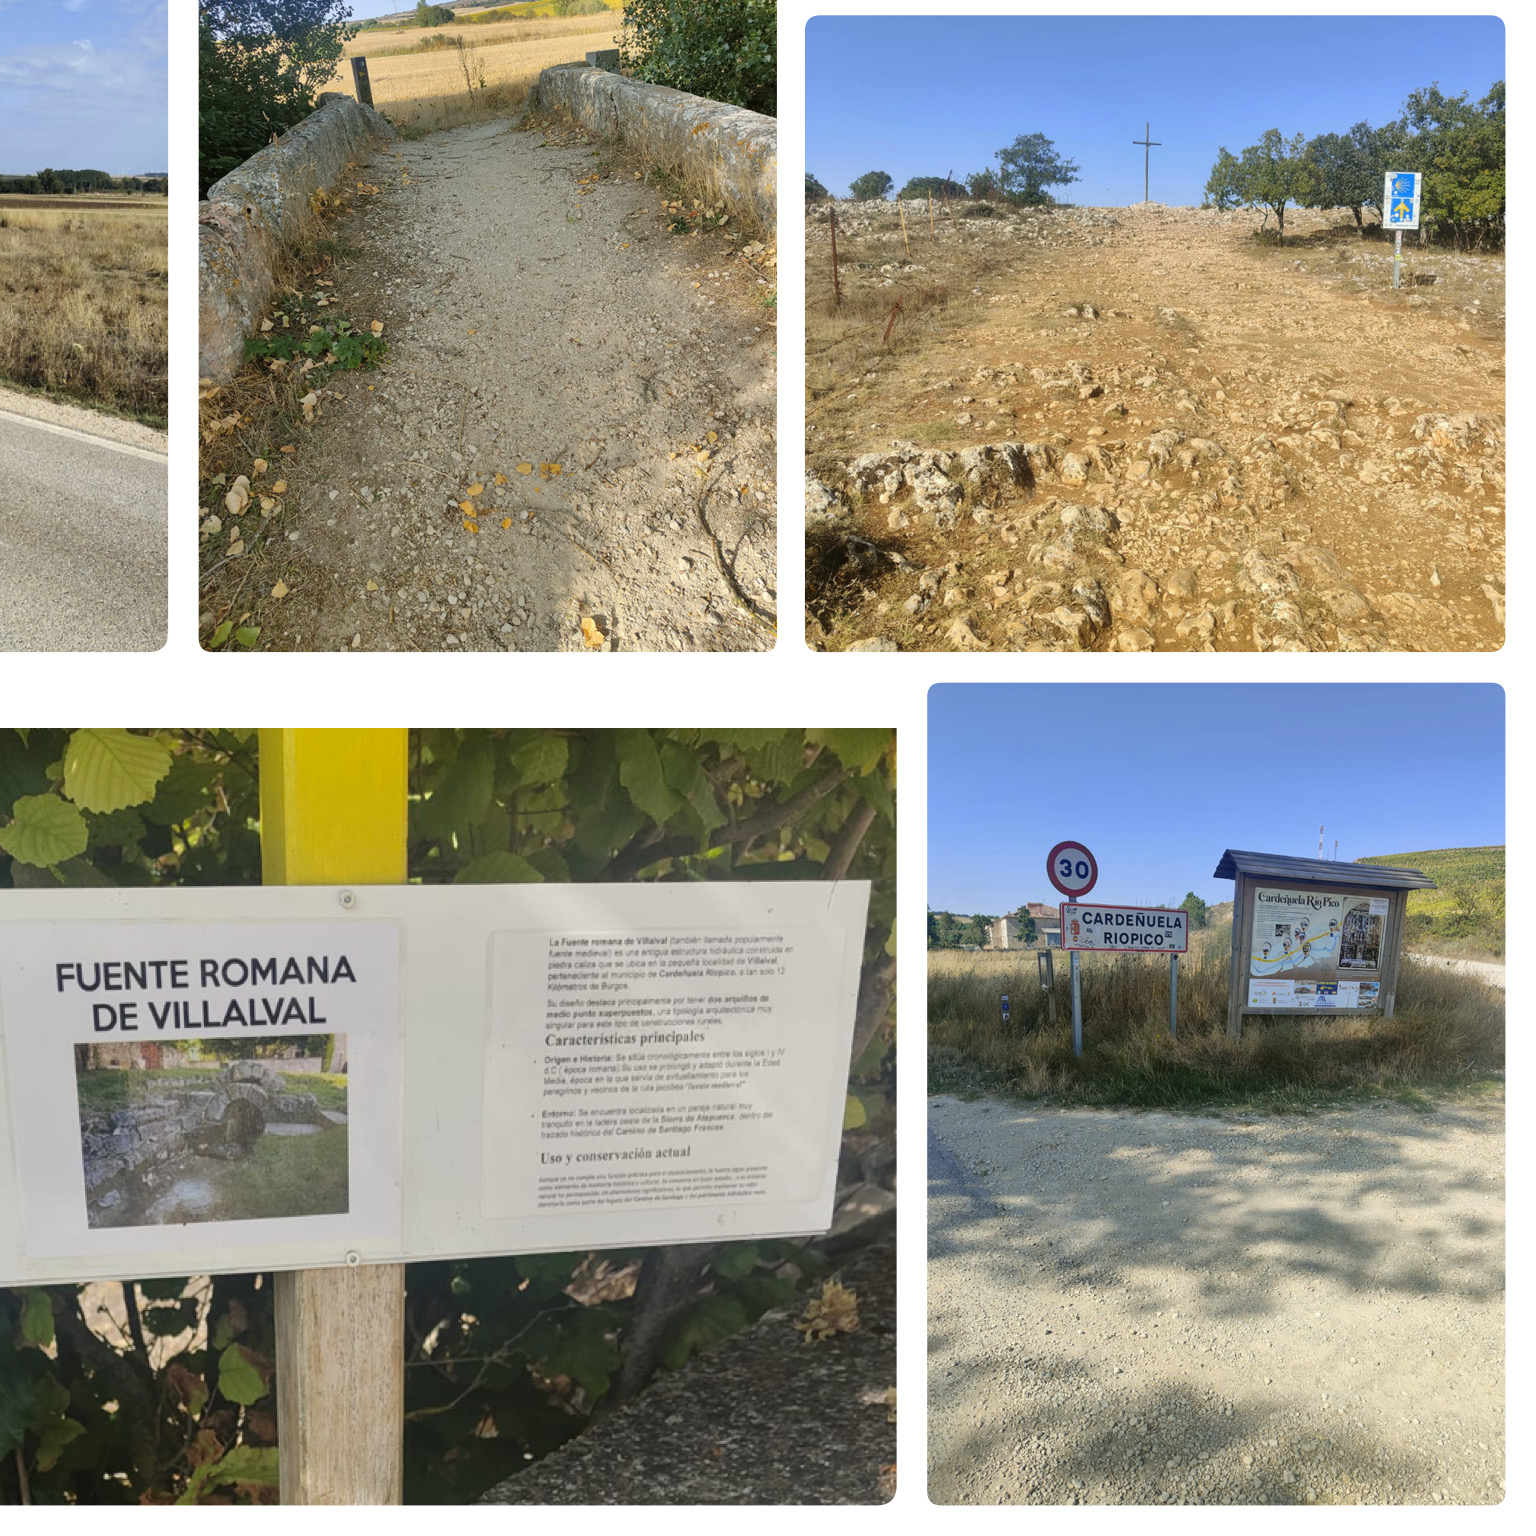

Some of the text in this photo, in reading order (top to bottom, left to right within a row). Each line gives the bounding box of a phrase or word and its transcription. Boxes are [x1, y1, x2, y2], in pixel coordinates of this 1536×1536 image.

[1059, 858, 1089, 879] 30
[1258, 891, 1340, 911] Cardeñuela Río Pico
[1082, 911, 1182, 929] CARDEÑUELA
[1103, 931, 1164, 946] RIOPICO
[55, 955, 357, 992] FUENTE ROMANA
[92, 996, 327, 1032] DE VILLALVAL
[545, 1031, 705, 1046] Características principales
[576, 1151, 652, 1161] conservación
[656, 1147, 690, 1158] actual
